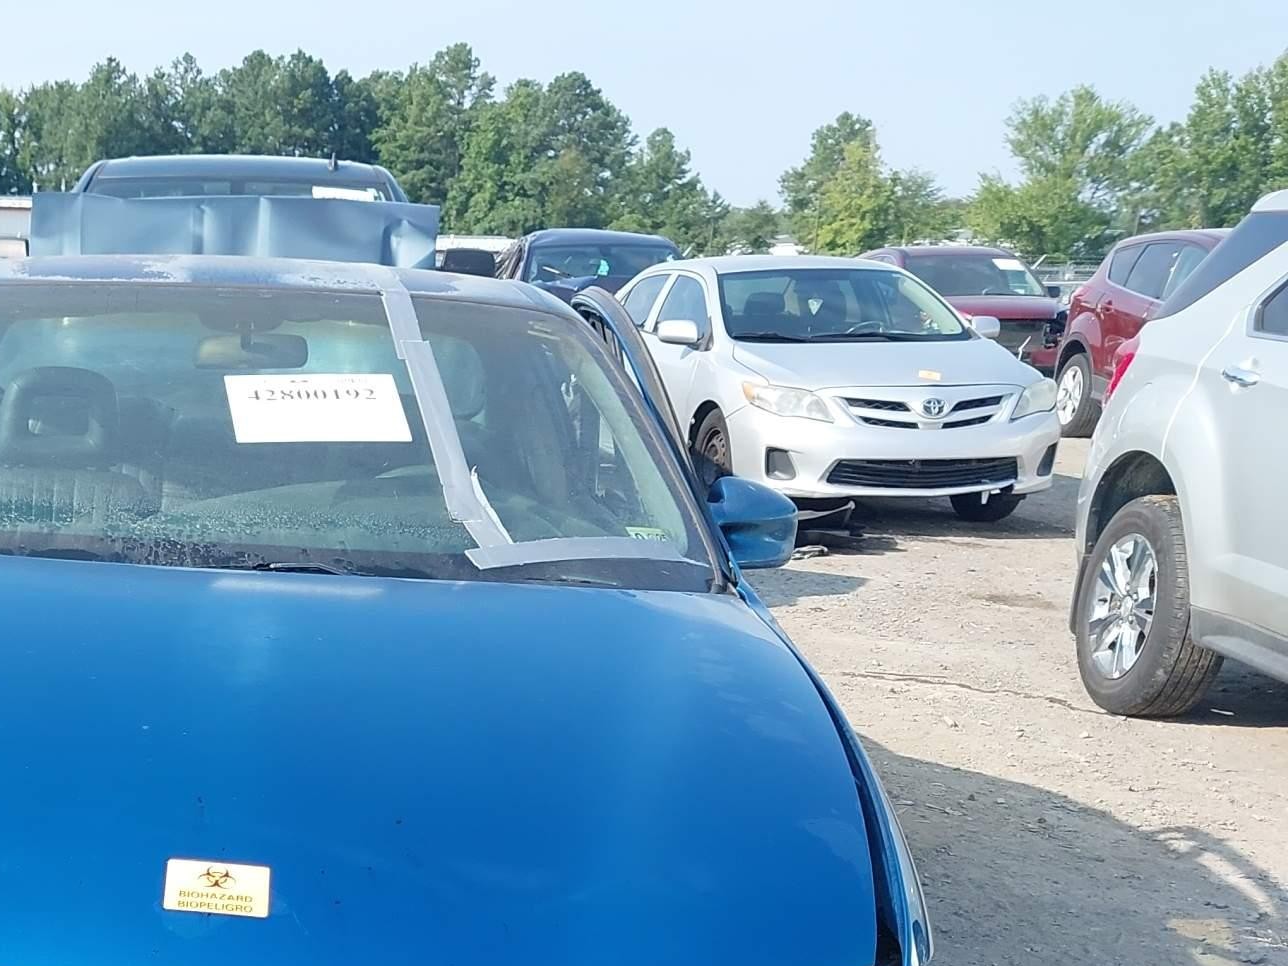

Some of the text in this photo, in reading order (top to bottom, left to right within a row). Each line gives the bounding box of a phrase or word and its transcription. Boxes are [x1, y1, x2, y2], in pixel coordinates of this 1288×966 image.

[248, 388, 377, 401] 42800192
[178, 890, 253, 903] BIOHAZARD
[177, 900, 253, 913] BIOPELIGRO
